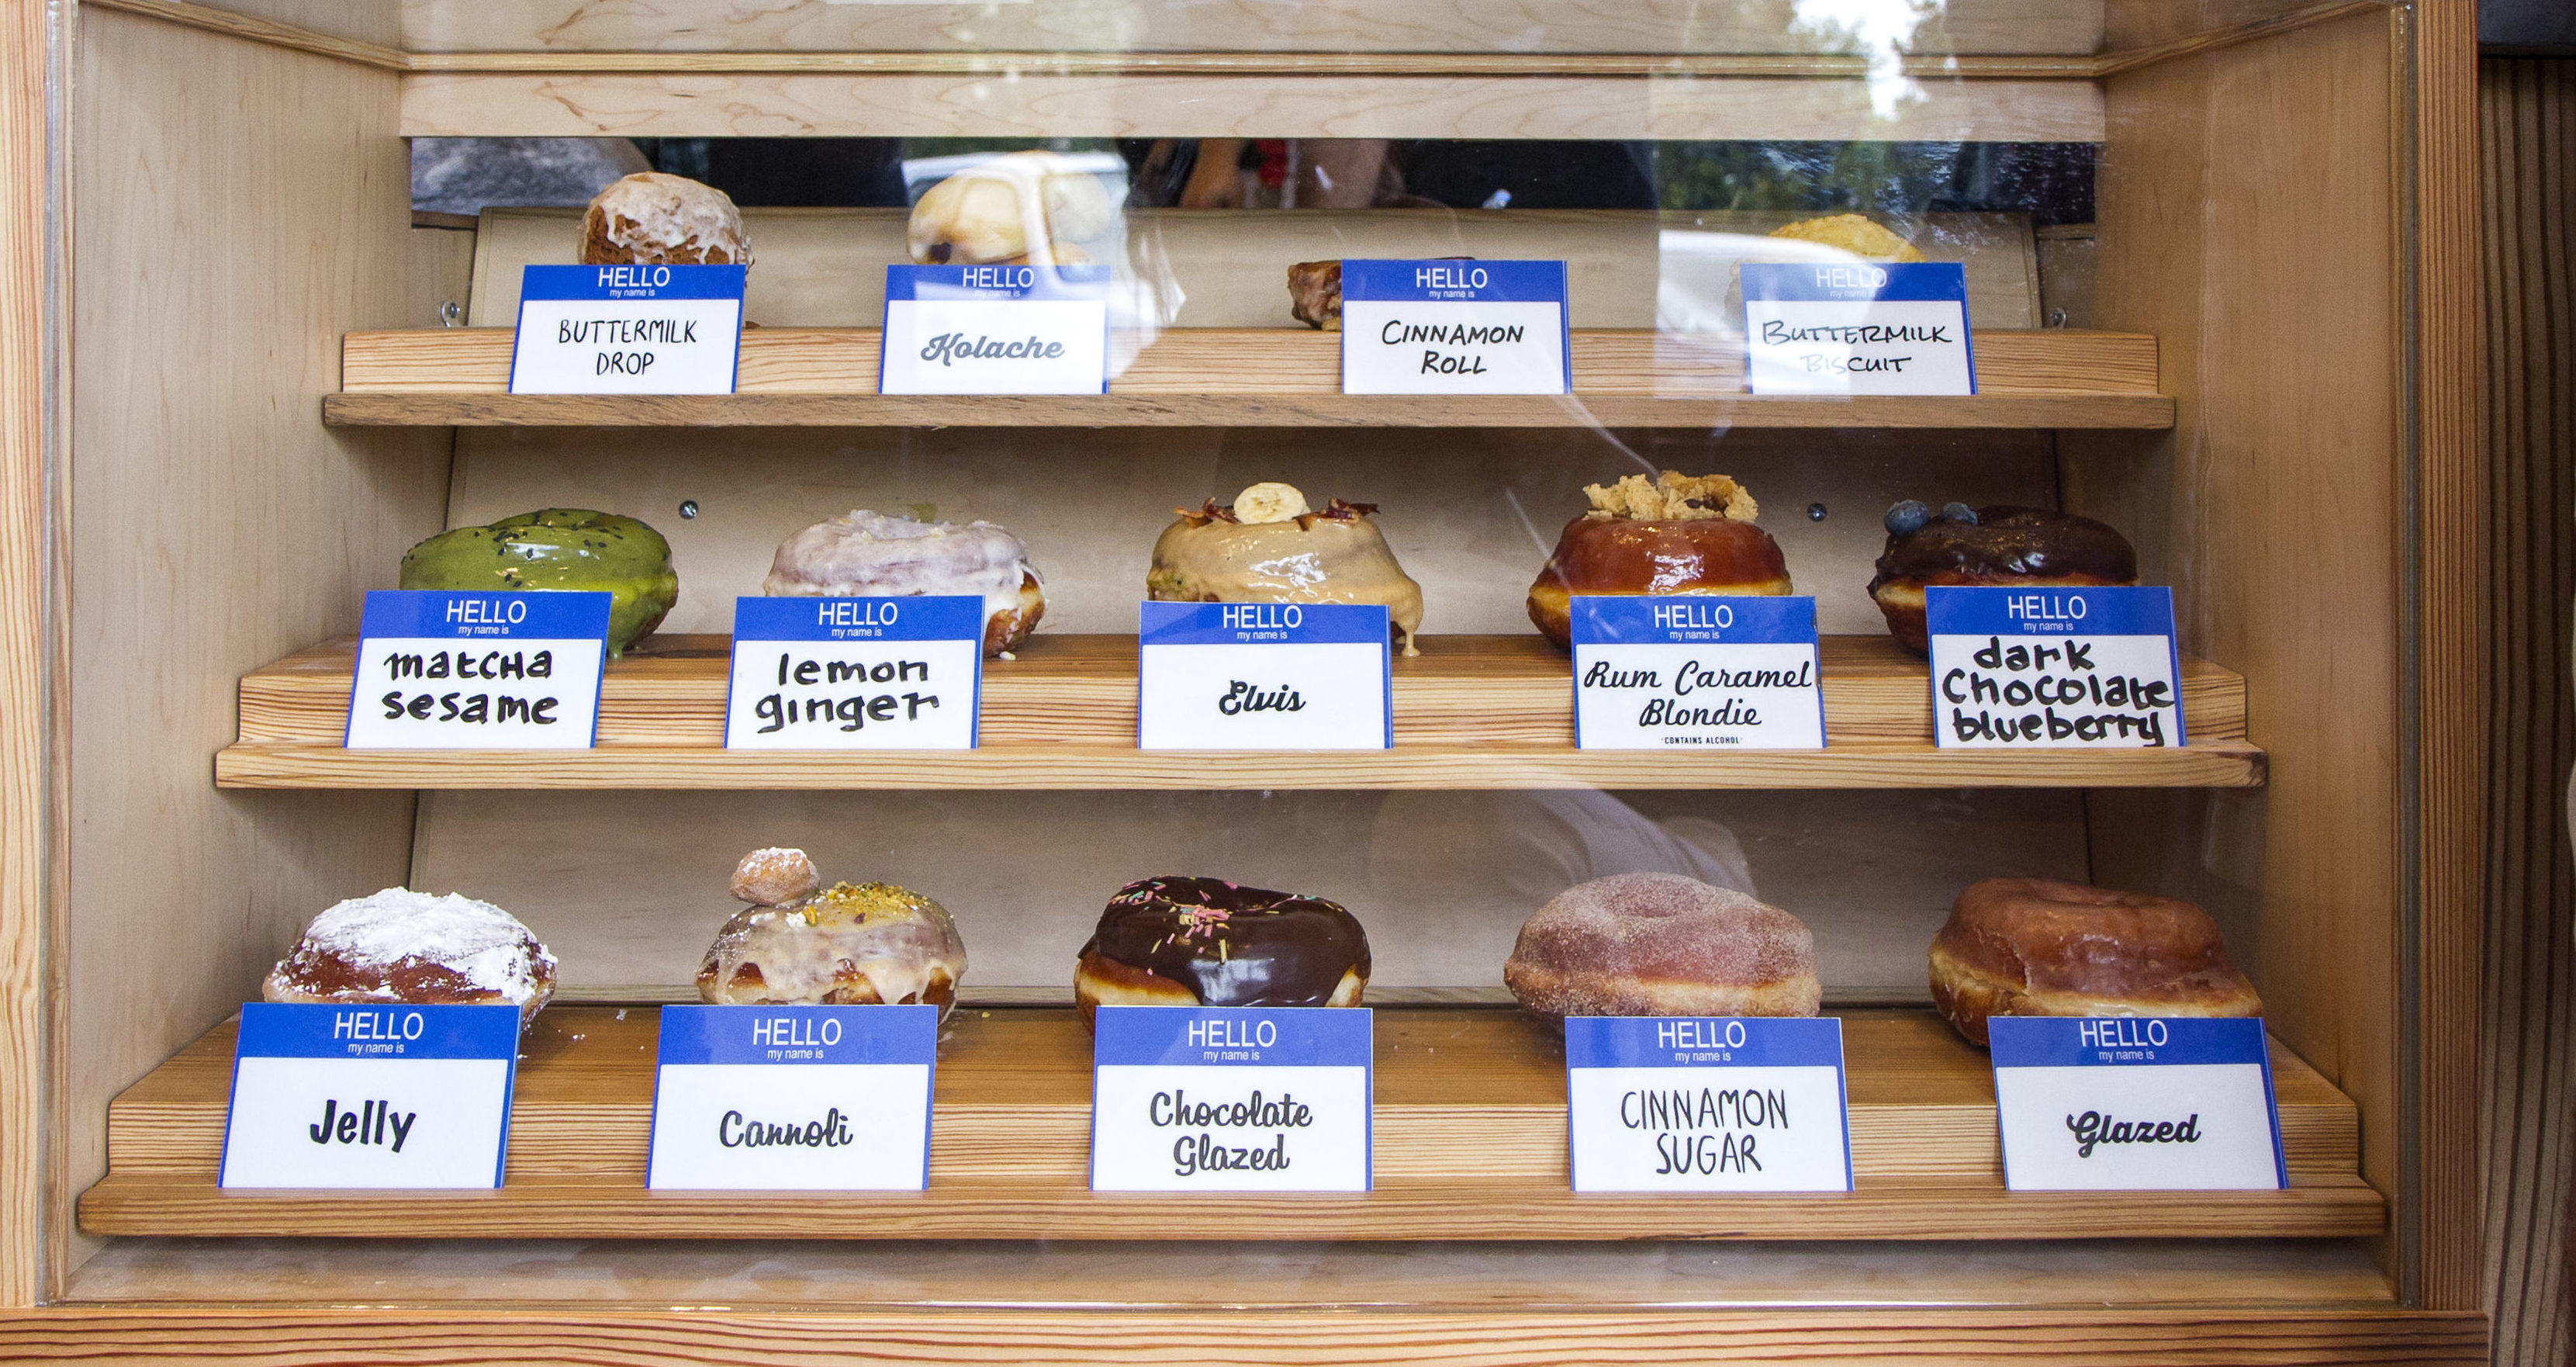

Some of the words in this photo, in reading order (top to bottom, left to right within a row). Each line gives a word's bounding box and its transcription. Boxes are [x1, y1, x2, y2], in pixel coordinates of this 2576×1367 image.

[598, 267, 671, 287] HELLO
[963, 268, 1034, 288] HELLO
[1416, 268, 1487, 288] HELLO
[1817, 268, 1886, 287] HELLO
[609, 289, 622, 299] my
[648, 289, 655, 297] is
[1430, 291, 1441, 299] my
[559, 320, 697, 343] BUTTERMILK
[1382, 320, 1523, 345] CINNAMON
[1763, 320, 1952, 344] BUTTERMILK
[921, 333, 1064, 366] Kolache
[596, 351, 654, 375] DROP
[1422, 350, 1487, 374] ROLL
[1800, 354, 1912, 373] BISCUIT
[447, 600, 526, 623] HELLO
[819, 602, 897, 625] HELLO
[1223, 605, 1302, 628] HELLO
[1655, 605, 1733, 628] HELLO
[2008, 596, 2087, 619] HELLO
[458, 625, 472, 636] my
[500, 625, 509, 634] is
[832, 628, 845, 639] my
[847, 628, 872, 636] name
[873, 627, 882, 636] is
[1237, 631, 1250, 642] my
[1280, 630, 1288, 639] is
[1670, 630, 1683, 641] my
[1686, 631, 1709, 639] name
[1710, 630, 1719, 639] is
[2024, 623, 2036, 632] my
[2066, 621, 2073, 631] is
[1973, 635, 2095, 671] dark
[779, 653, 928, 686] lemon
[1584, 661, 1661, 687] Rum
[1675, 660, 1812, 696] Caramel
[382, 691, 558, 725] sesame
[1219, 680, 1306, 715] Elvis
[756, 692, 939, 733] ginger
[1639, 698, 1762, 727] Blondie
[1953, 707, 2166, 746] blueberry
[334, 1012, 424, 1040] HELLO
[753, 1019, 842, 1045] HELLO
[1189, 1020, 1276, 1047] HELLO
[1658, 1020, 1746, 1049] HELLO
[2080, 1020, 2168, 1047] HELLO
[348, 1044, 363, 1055] my
[365, 1044, 392, 1053] name
[394, 1042, 404, 1053] is
[768, 1049, 783, 1061] my
[785, 1050, 812, 1058] name
[814, 1048, 824, 1059] is
[1204, 1051, 1219, 1063] my
[1222, 1051, 1247, 1061] name
[1250, 1050, 1260, 1060] is
[1675, 1053, 1691, 1064] my
[1693, 1053, 1720, 1062] name
[1723, 1050, 1731, 1061] is
[2099, 1050, 2113, 1063] my
[2116, 1051, 2143, 1060] name
[2146, 1050, 2155, 1060] is
[1150, 1090, 1312, 1127] Chocolate
[1621, 1088, 1788, 1130] CINNAMON
[310, 1099, 416, 1153] Jelly
[720, 1108, 853, 1147] Cannoli
[2066, 1111, 2201, 1158] Glazed
[1174, 1133, 1290, 1176] Glazed
[1656, 1132, 1762, 1175] SUGAR
